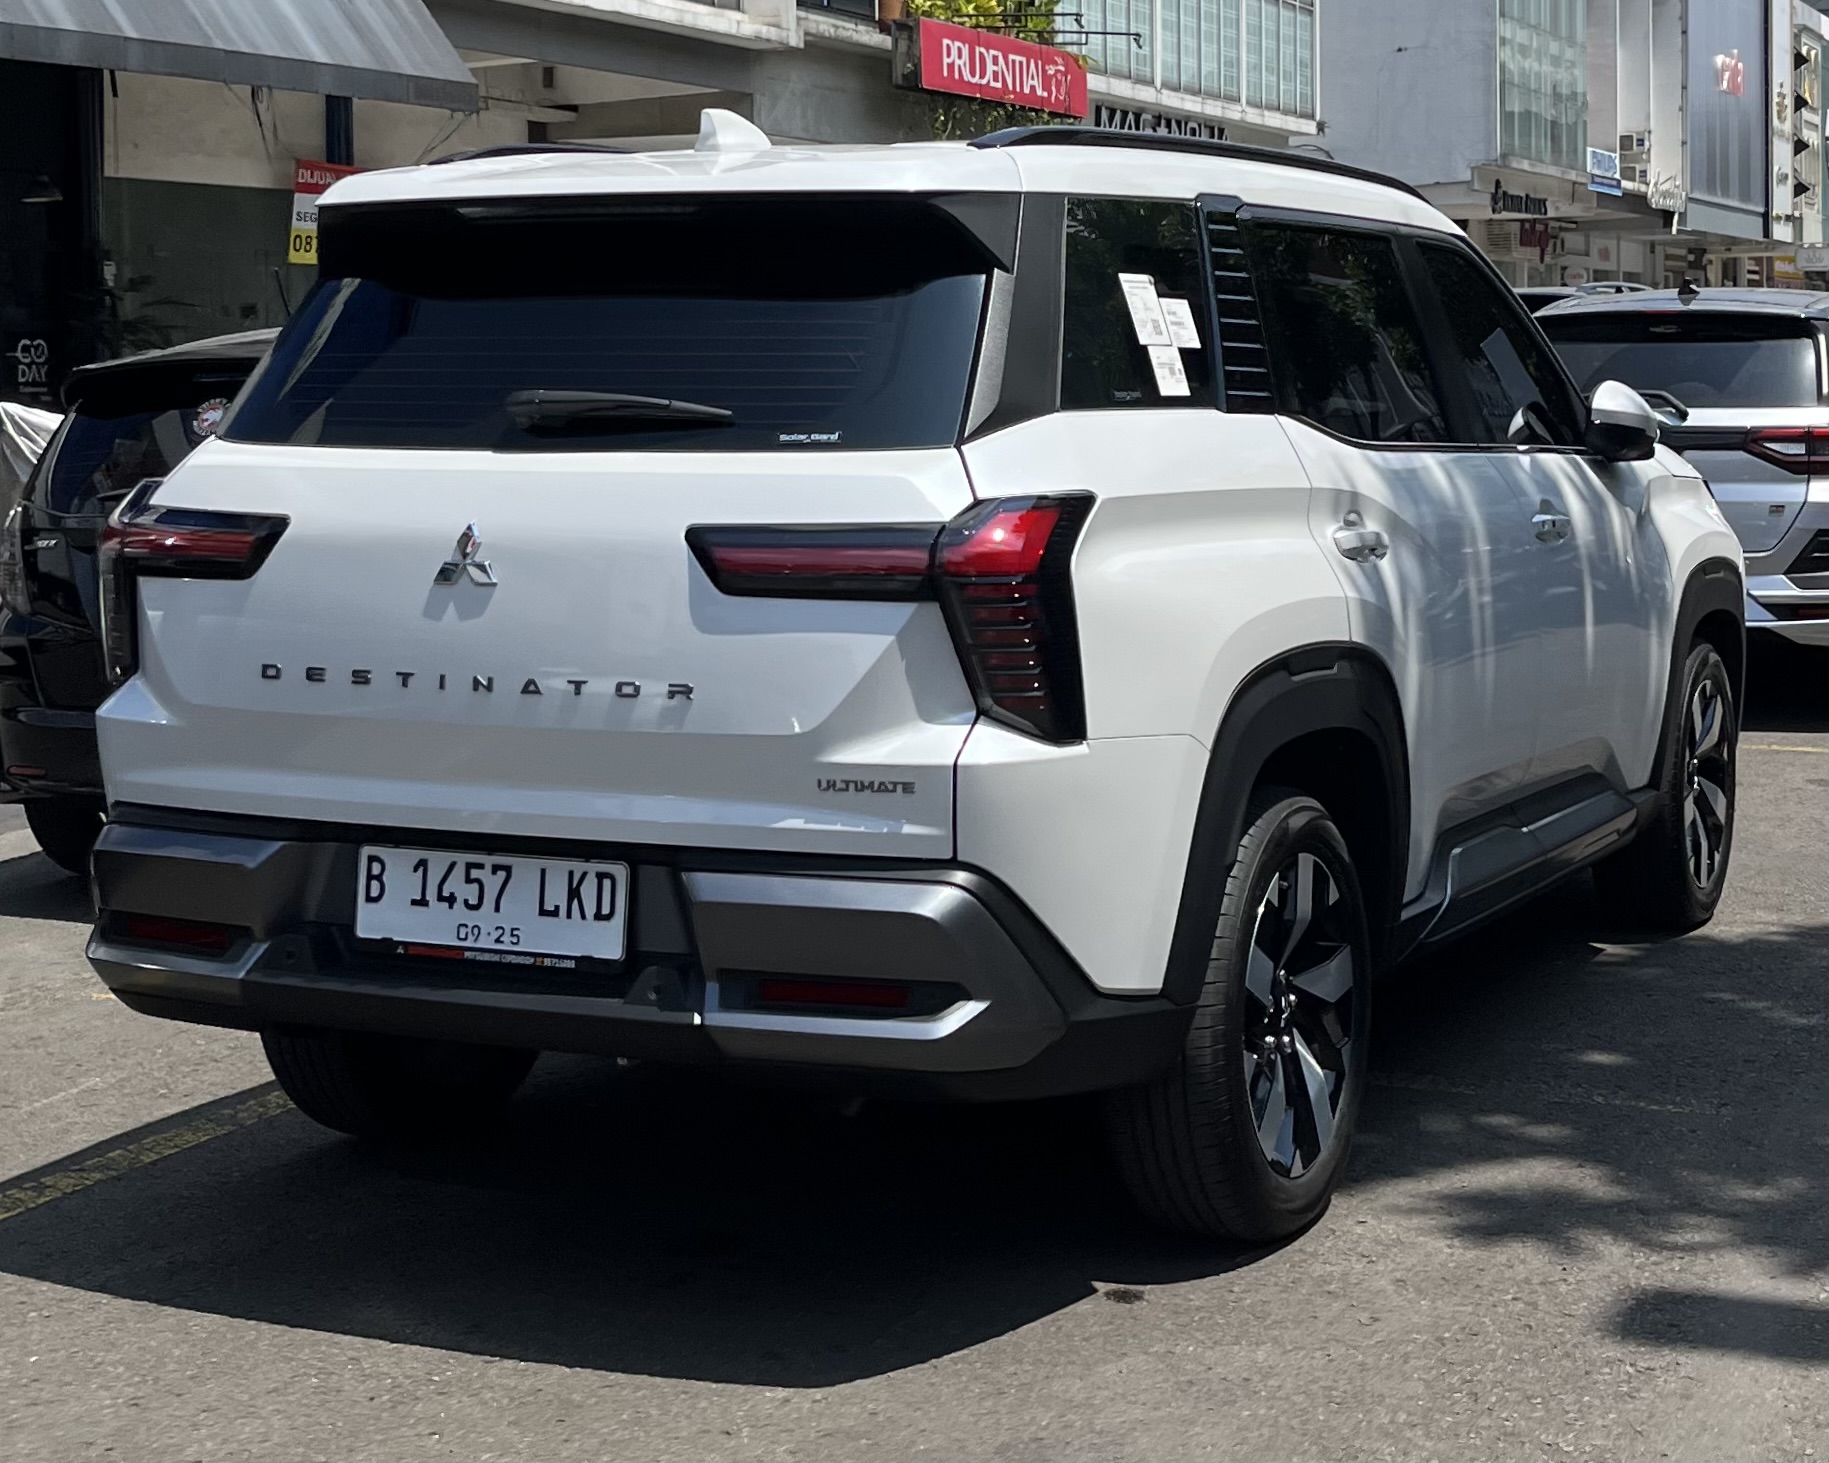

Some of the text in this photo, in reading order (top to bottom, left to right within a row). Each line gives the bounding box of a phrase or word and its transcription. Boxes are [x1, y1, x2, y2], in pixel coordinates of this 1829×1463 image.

[942, 37, 1048, 98] PRUDENTIAL
[261, 663, 694, 700] DESTINATOR
[817, 778, 916, 794] ULTIMATE
[365, 854, 617, 922] B 1457 LKD
